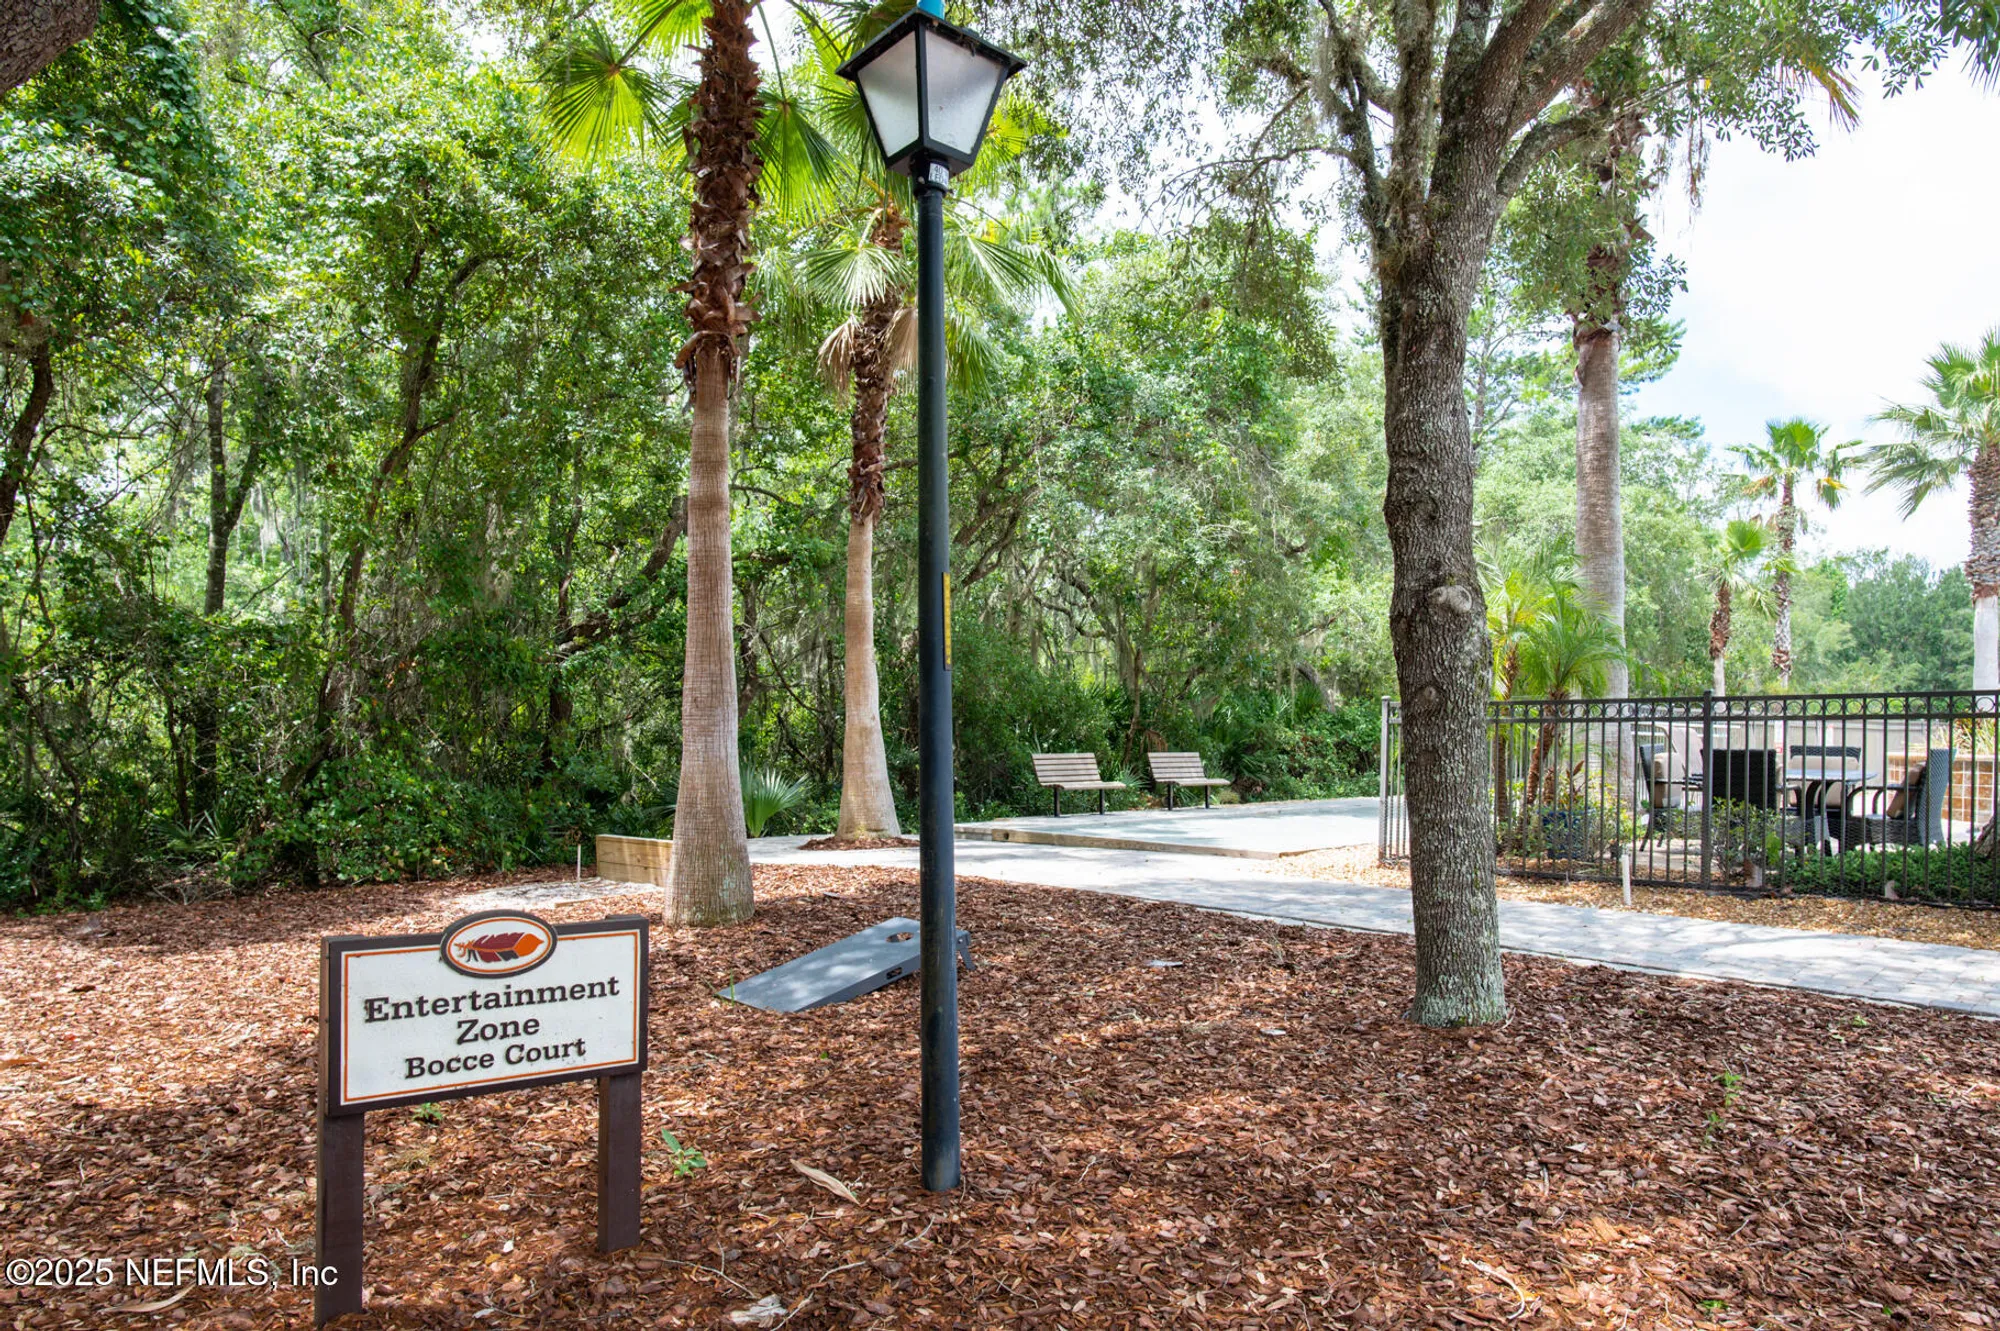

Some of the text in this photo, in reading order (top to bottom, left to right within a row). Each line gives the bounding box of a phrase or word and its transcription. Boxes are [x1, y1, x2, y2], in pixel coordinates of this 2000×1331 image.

[364, 976, 620, 1023] Entertainment
[456, 1017, 540, 1045] Zone
[405, 1037, 586, 1079] Bocce Court
